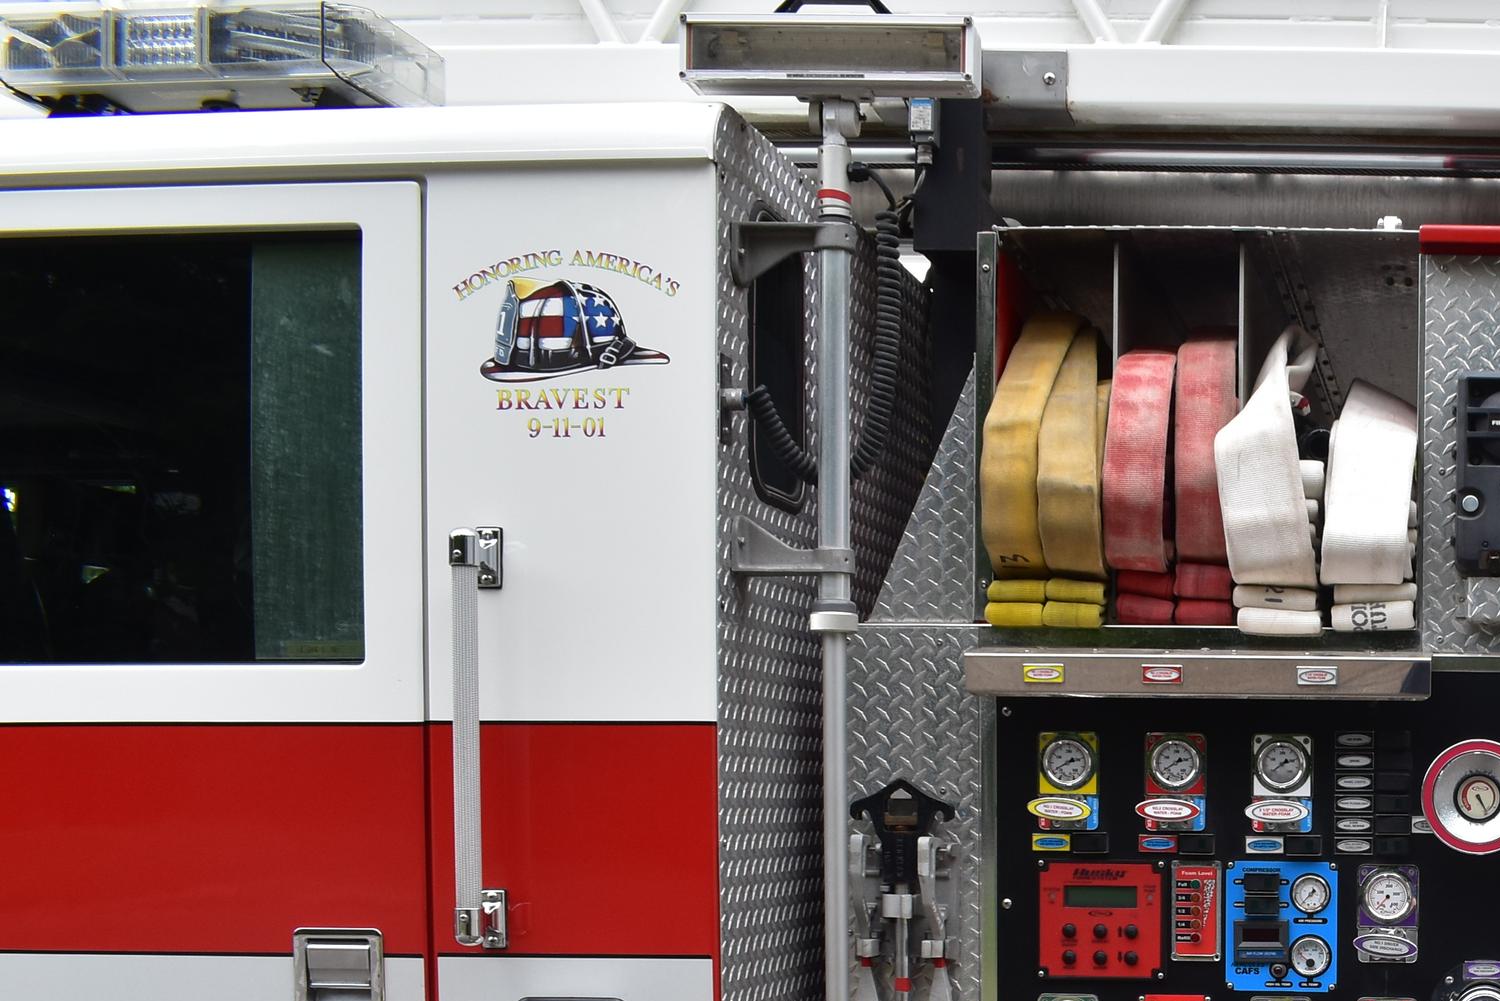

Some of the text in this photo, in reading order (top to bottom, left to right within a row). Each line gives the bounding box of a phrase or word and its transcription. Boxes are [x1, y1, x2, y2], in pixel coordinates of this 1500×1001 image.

[452, 250, 681, 301] HONORING AMERICA'S
[496, 387, 631, 411] BRAVEST
[527, 416, 606, 438] 9-11-01
[1235, 967, 1260, 975] CAFS
